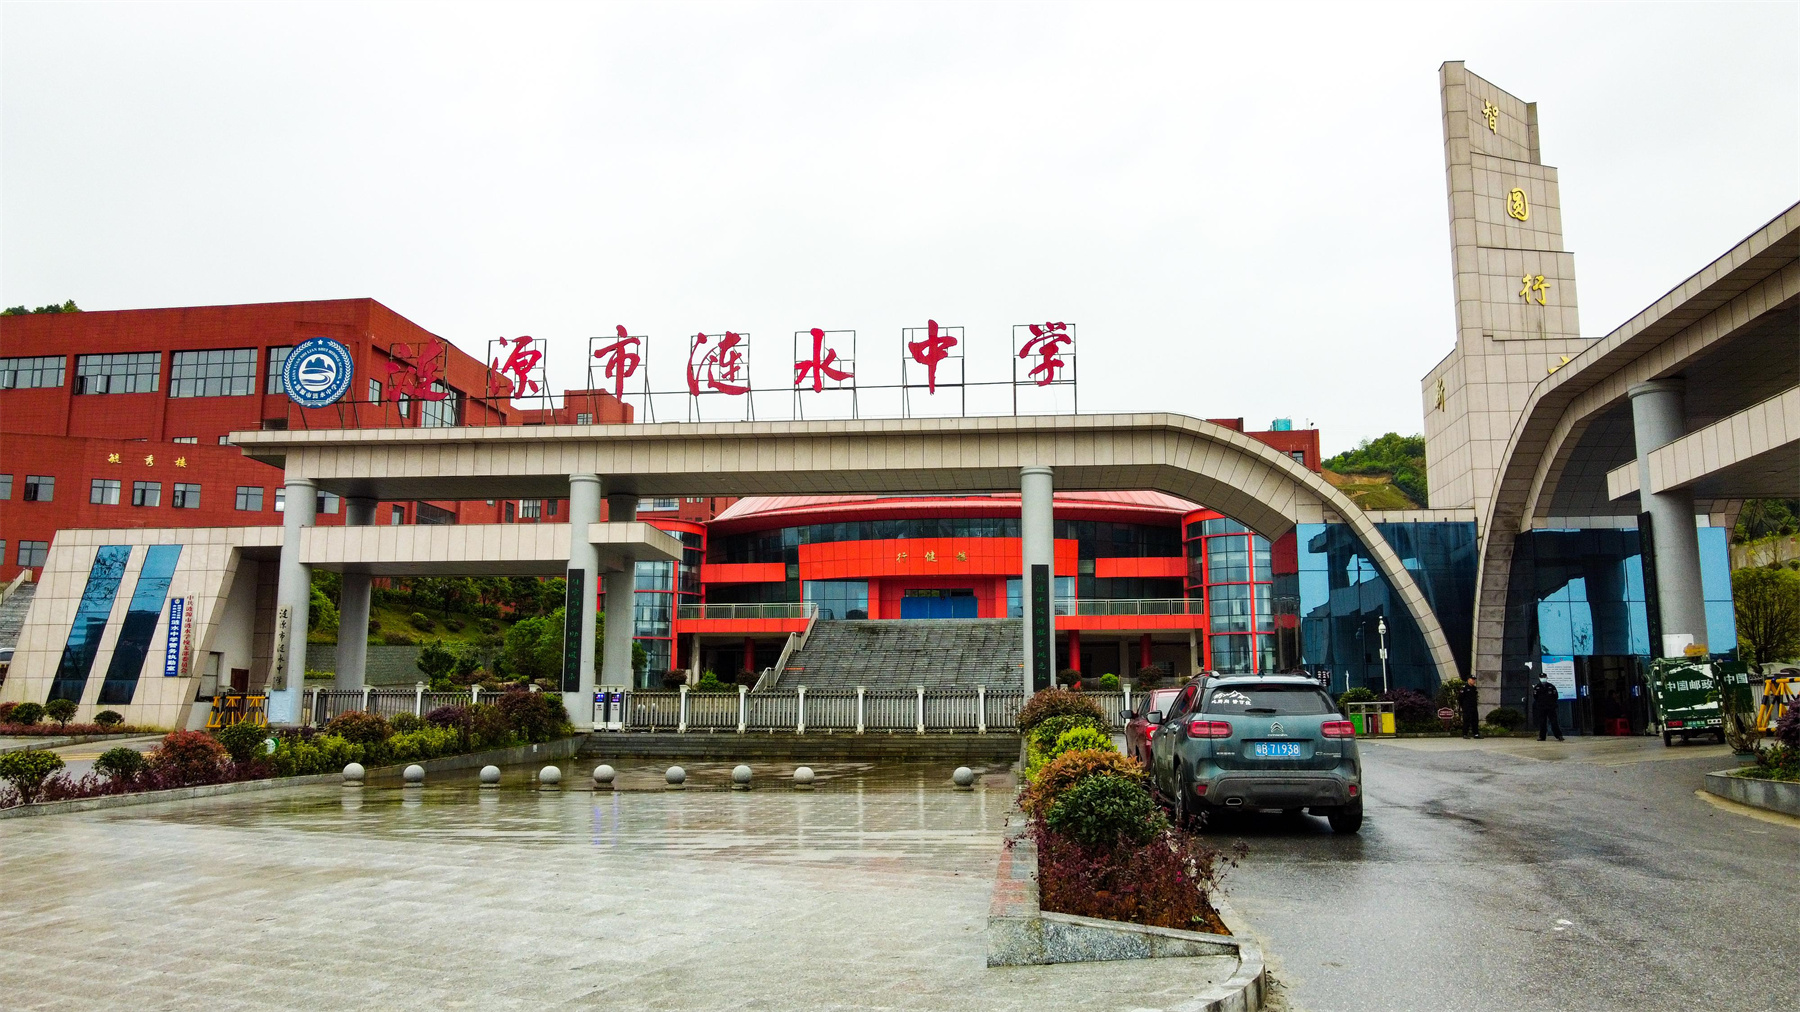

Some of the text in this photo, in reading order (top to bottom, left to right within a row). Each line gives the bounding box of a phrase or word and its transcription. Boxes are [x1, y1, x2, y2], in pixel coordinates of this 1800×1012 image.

[385, 319, 1072, 402] 涟源市涟水中学
[1666, 678, 1714, 692] 中国邮政
[1723, 672, 1749, 685] 中国
